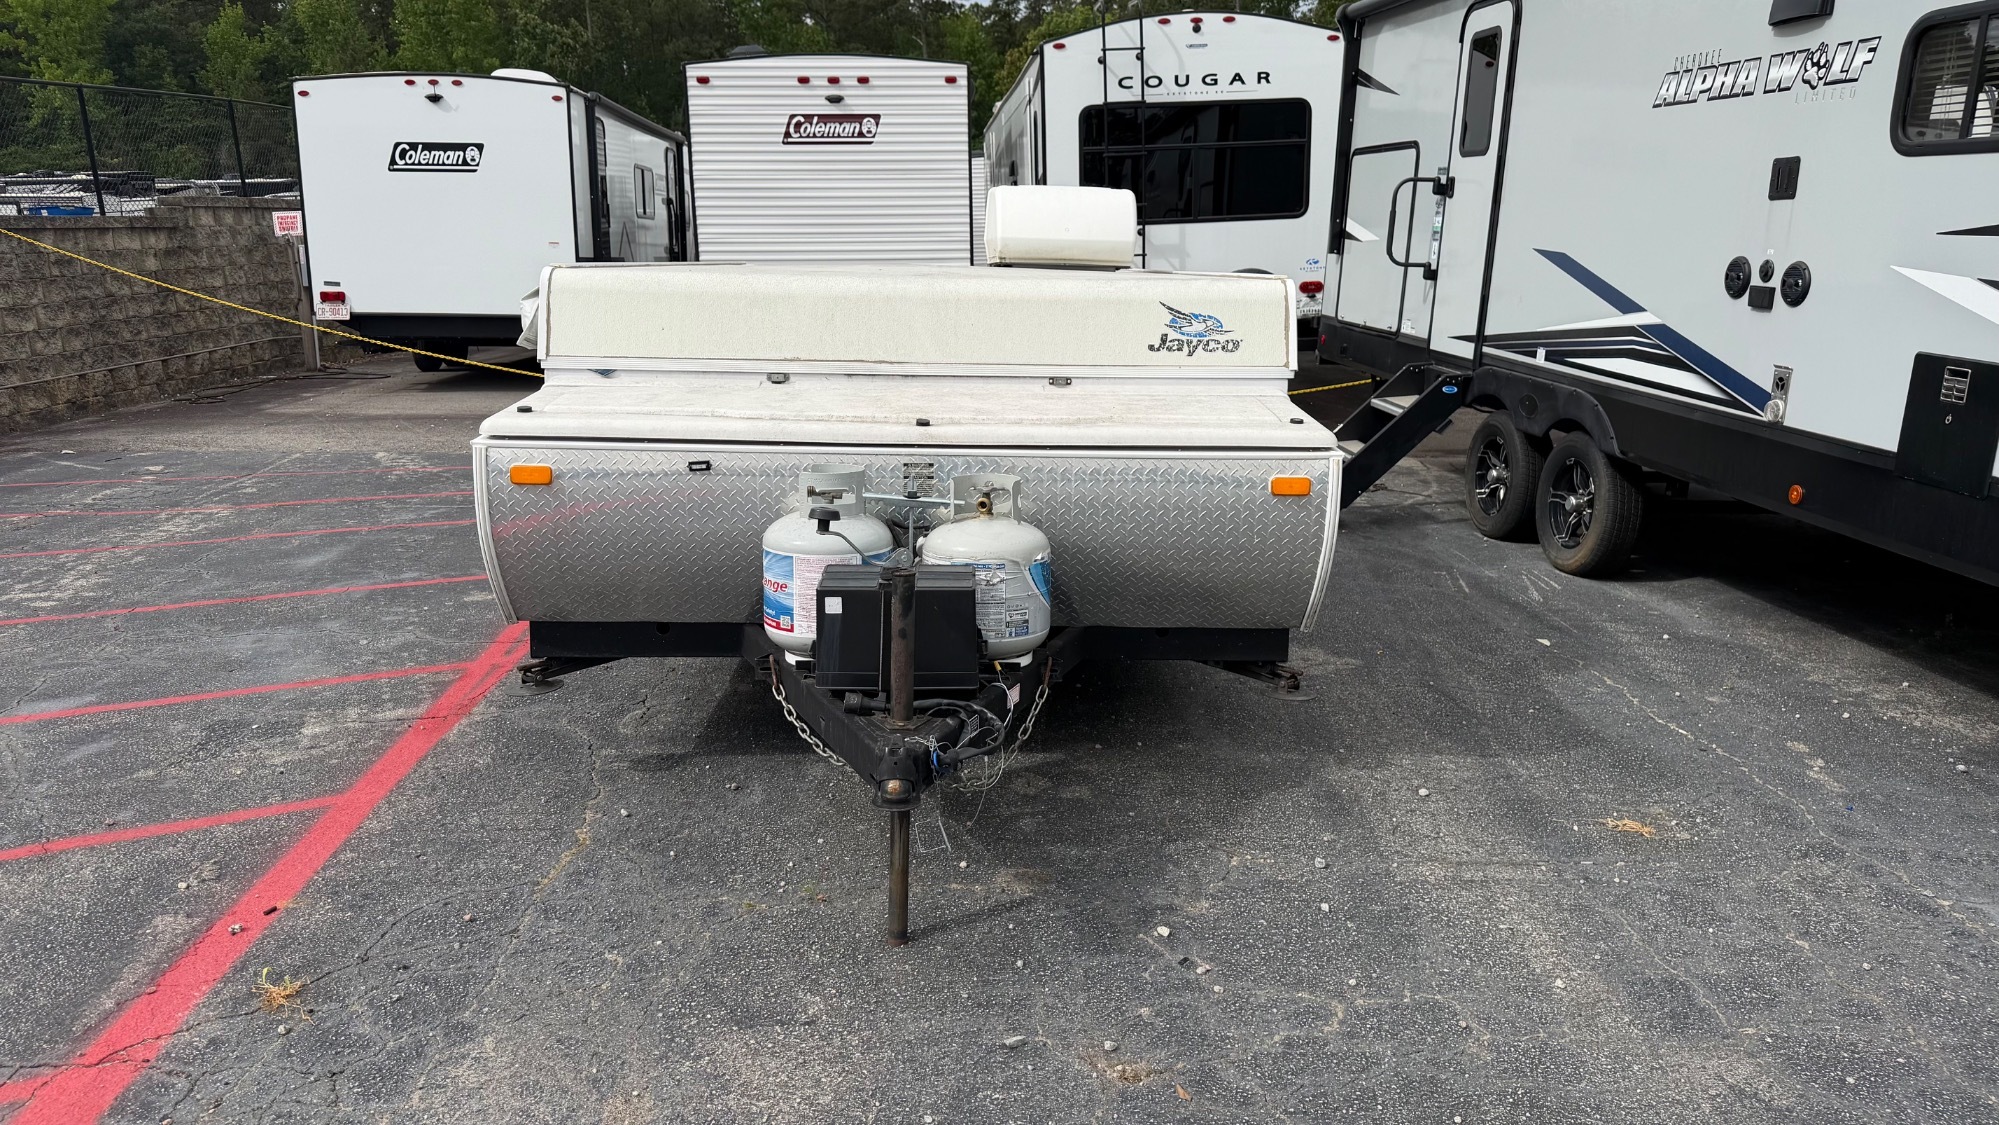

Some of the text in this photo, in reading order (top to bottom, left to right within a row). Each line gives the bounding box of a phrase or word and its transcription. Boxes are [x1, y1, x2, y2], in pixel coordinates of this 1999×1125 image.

[1673, 48, 1722, 71] CHEROKEE
[1117, 71, 1272, 90] COUGAR
[1652, 57, 1763, 108] ALPHA
[1794, 85, 1857, 105] LIMITED
[789, 115, 861, 138] Coleman
[394, 143, 465, 165] Coleman
[1147, 333, 1240, 357] Jayco
